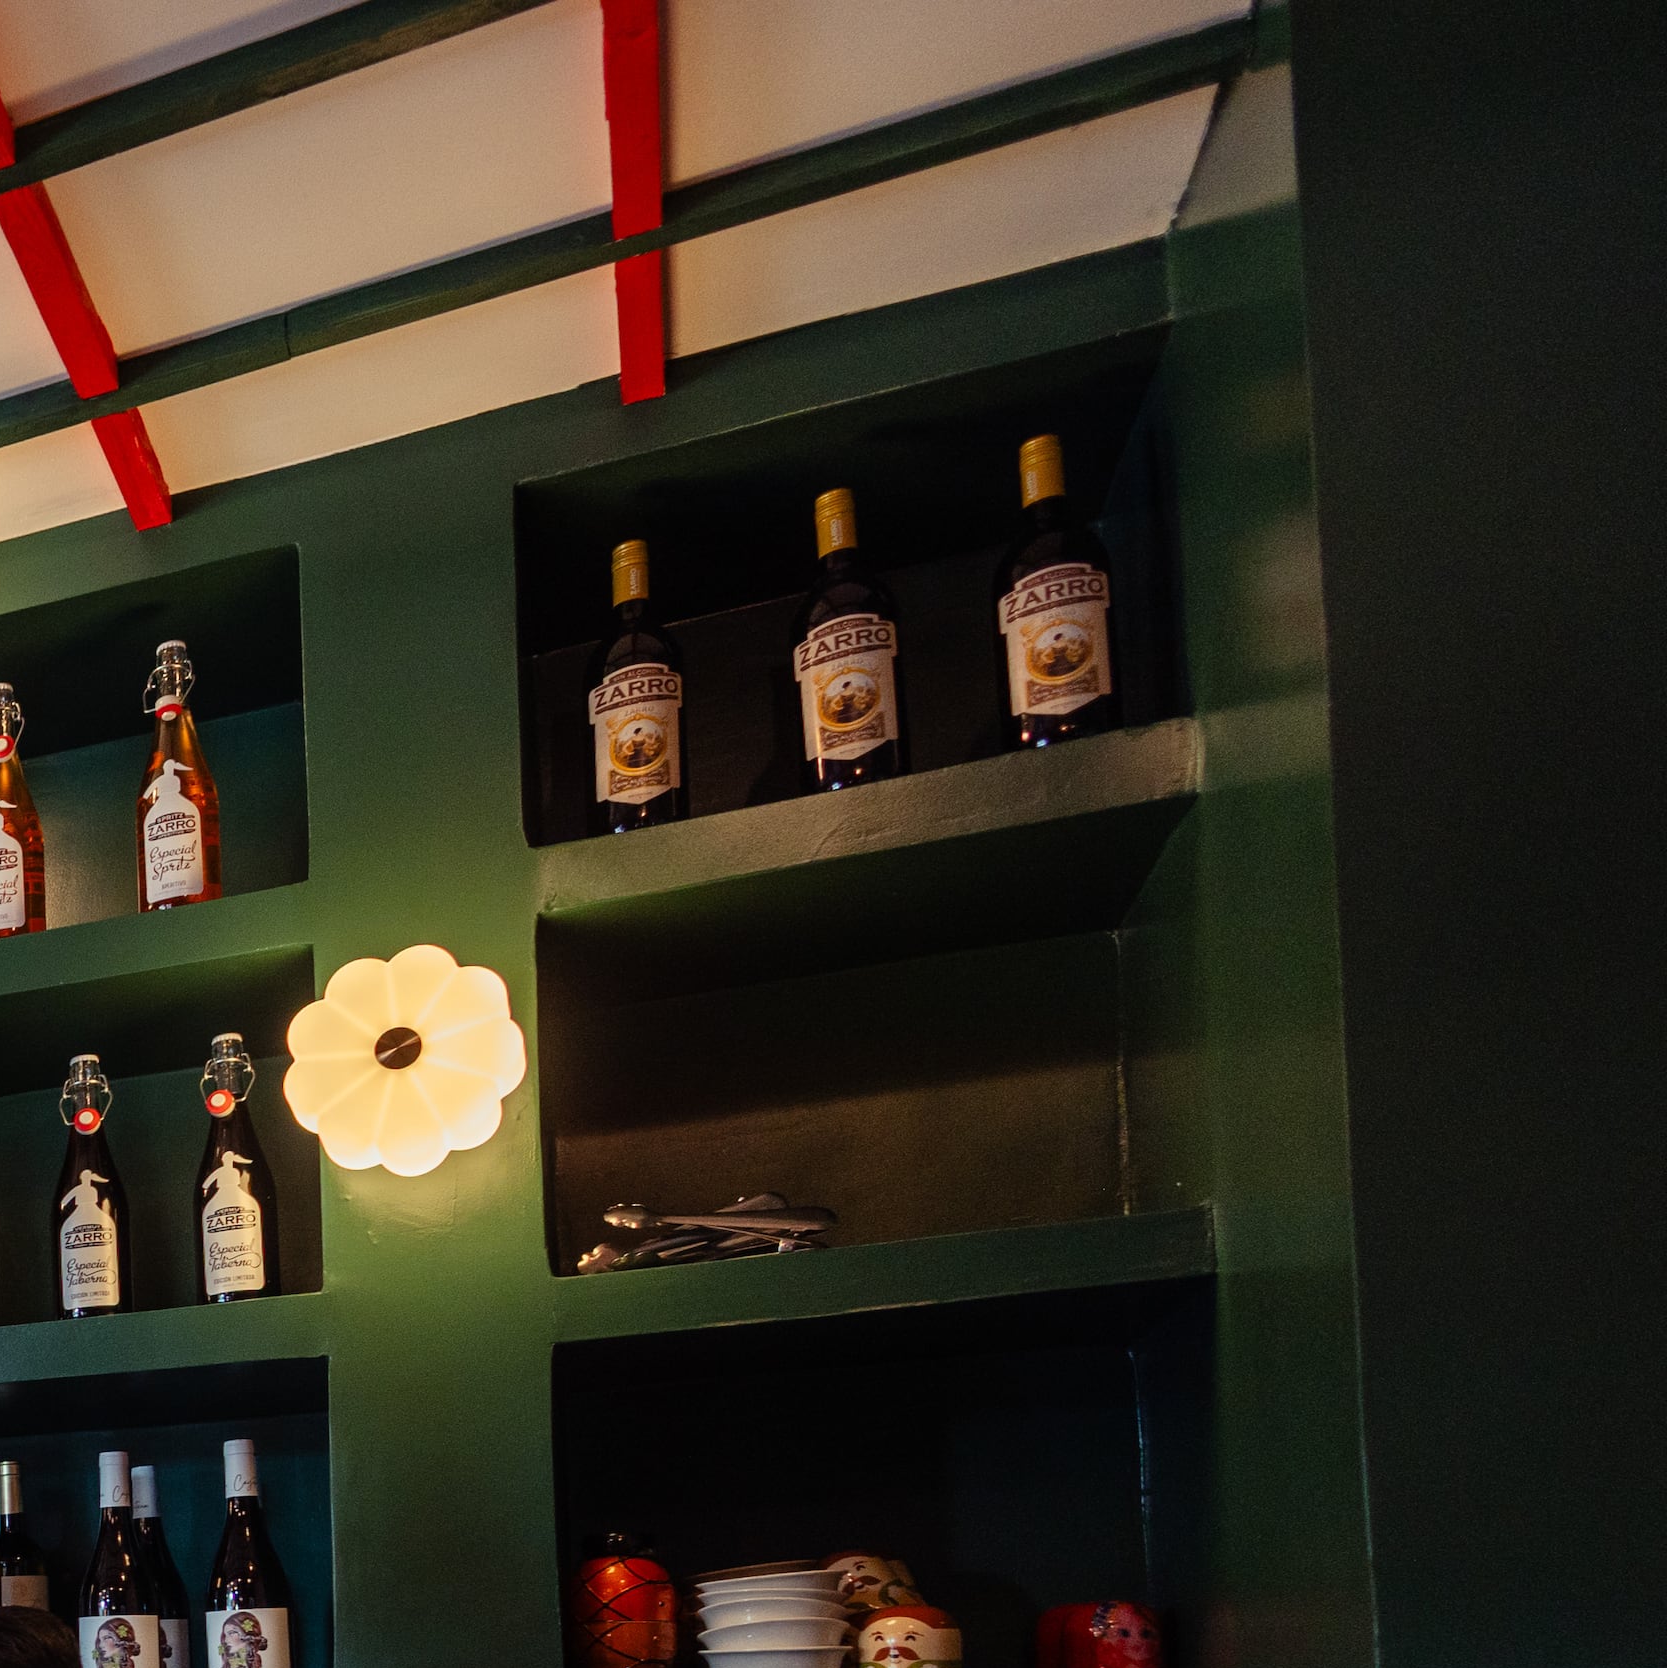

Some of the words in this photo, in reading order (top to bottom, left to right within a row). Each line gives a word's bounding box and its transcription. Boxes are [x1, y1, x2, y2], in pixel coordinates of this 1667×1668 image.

[1004, 576, 1106, 618] ZARRO
[799, 627, 891, 665] ZARRO
[594, 677, 678, 709] ZARRO
[147, 819, 196, 837] ZARRO
[150, 840, 197, 863] Especial
[152, 856, 196, 882] Spritz
[206, 1214, 256, 1229] ZARRO
[65, 1232, 113, 1245] ZARRO
[209, 1239, 255, 1258] Especial
[68, 1256, 110, 1274] Especial
[209, 1252, 261, 1272] Taberna
[67, 1269, 116, 1288] Taberna
